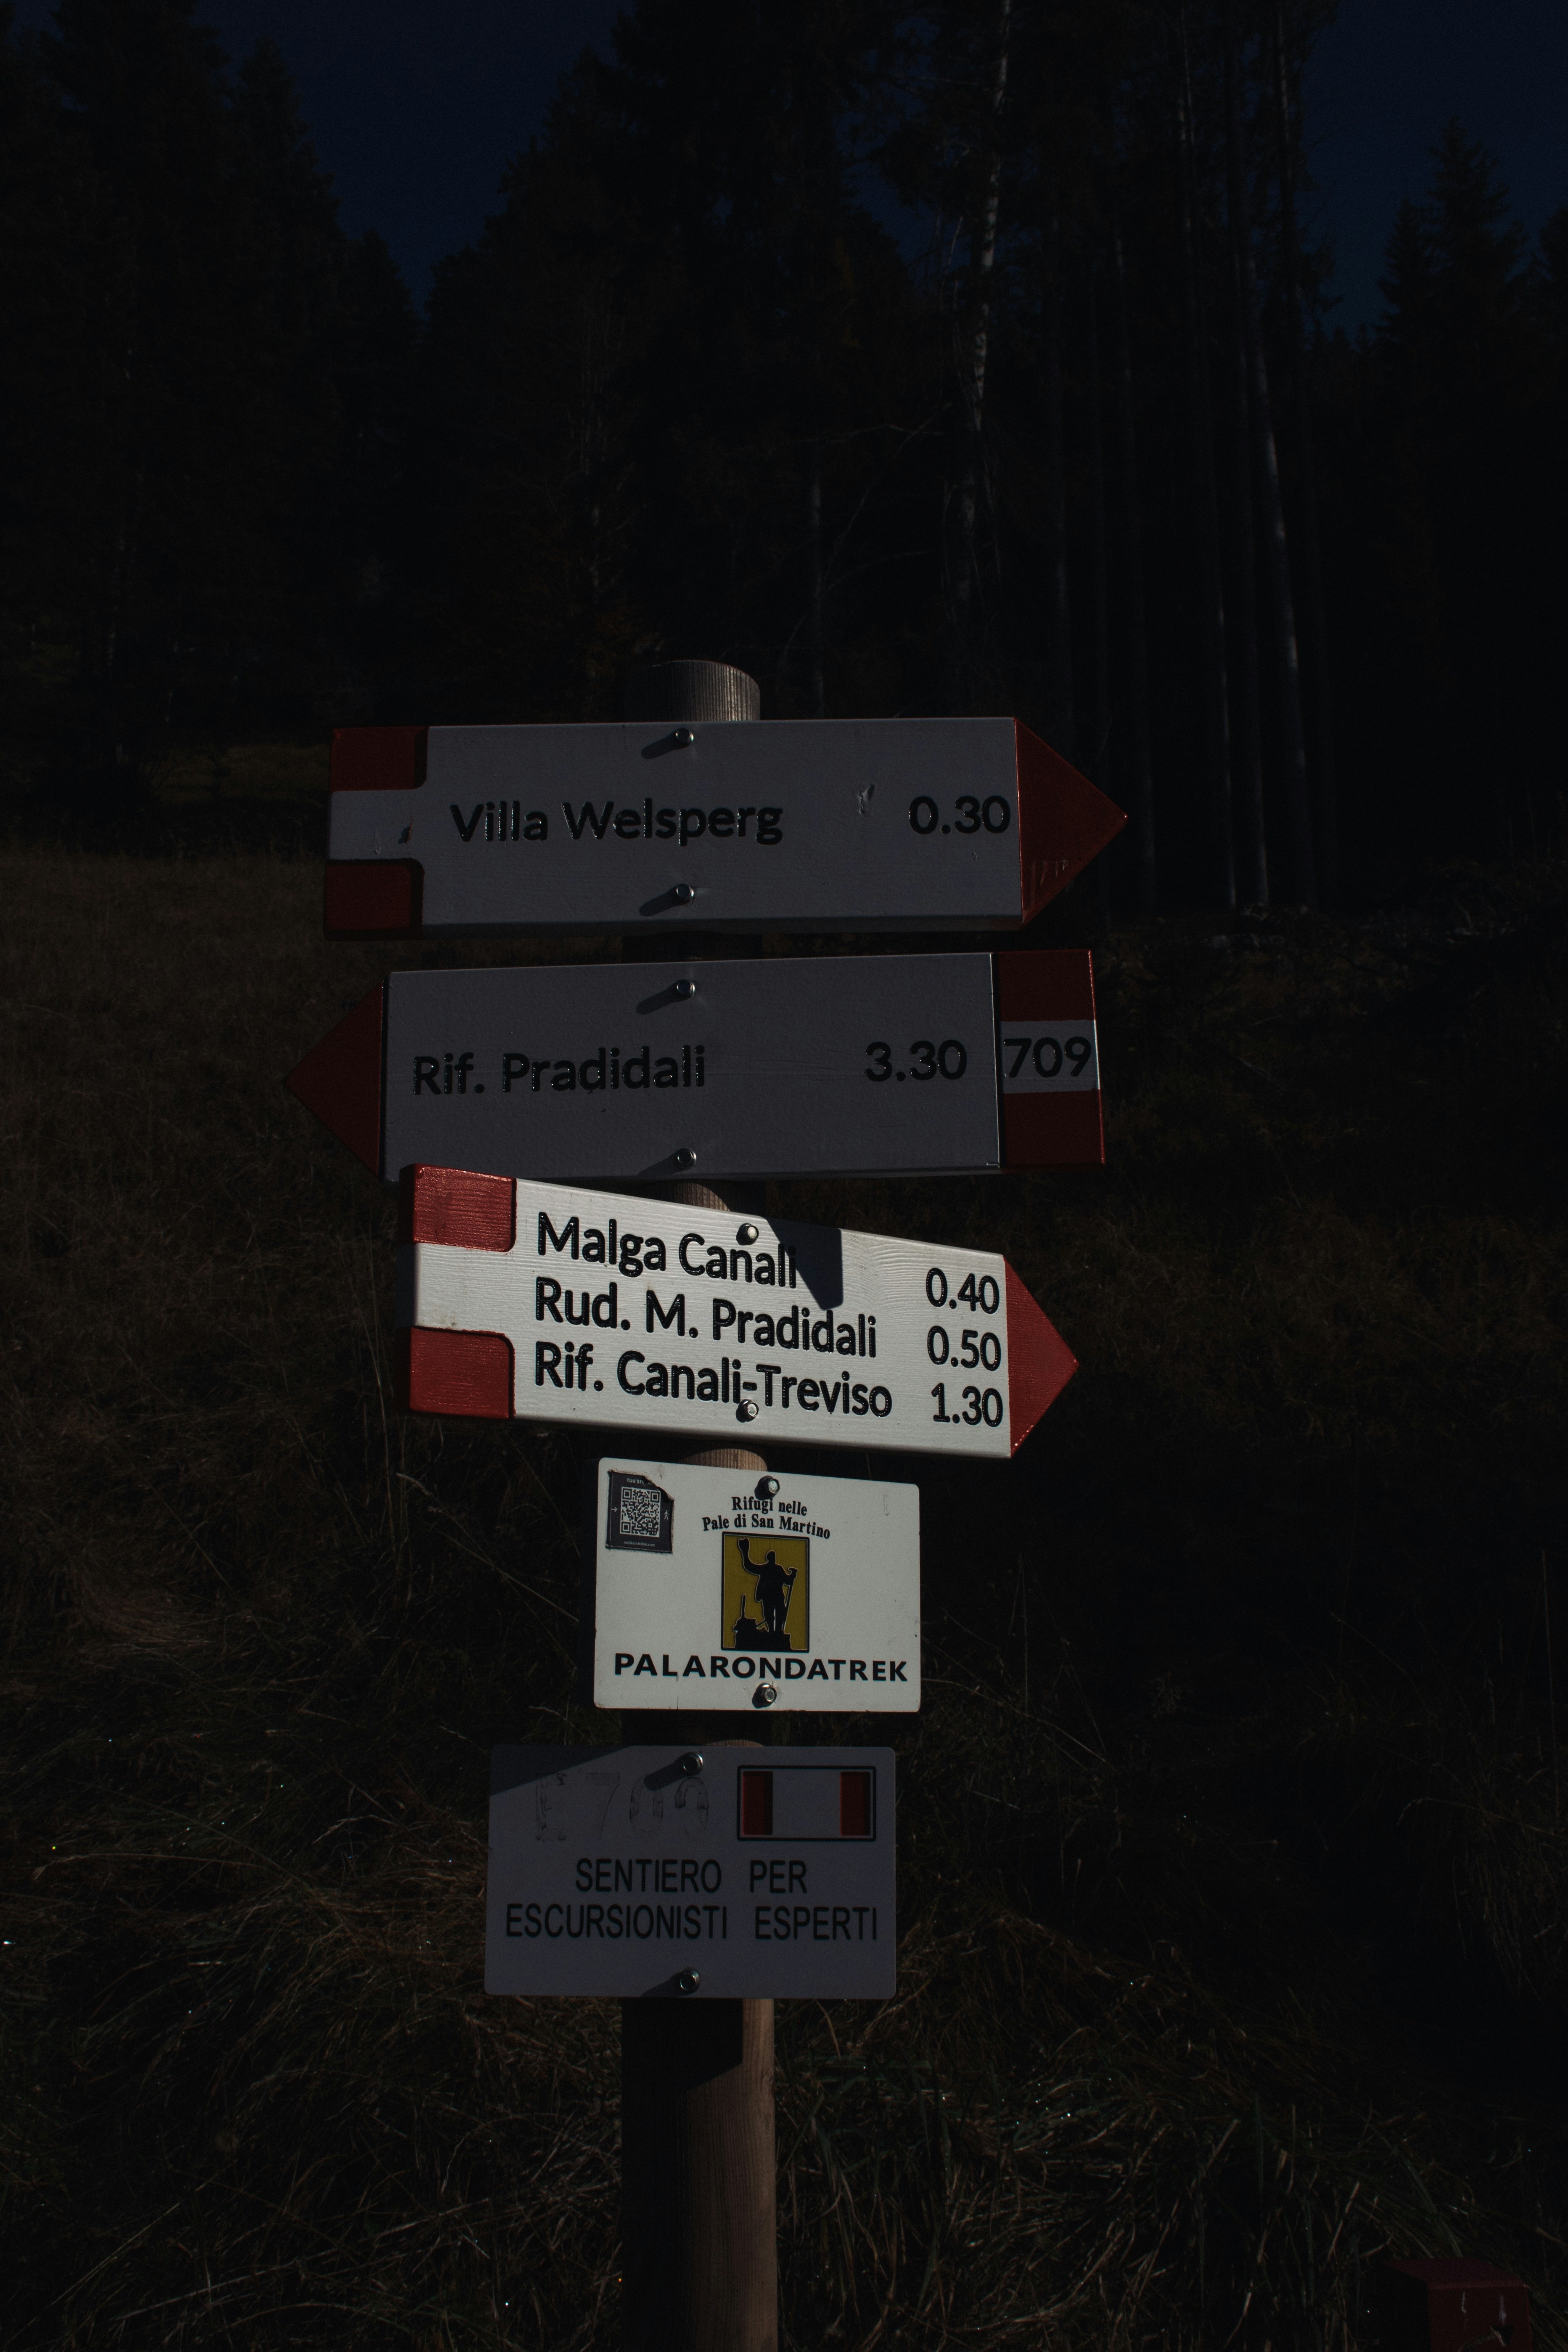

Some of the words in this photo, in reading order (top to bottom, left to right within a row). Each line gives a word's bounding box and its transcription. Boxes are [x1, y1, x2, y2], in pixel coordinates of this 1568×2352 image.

[449, 801, 548, 842] Villa
[562, 797, 783, 846] Welsperg
[908, 795, 1011, 835] 0.30
[412, 1053, 486, 1095] Rif.
[502, 1045, 706, 1092] Pradidali
[865, 1039, 968, 1081] 3.30
[1003, 1036, 1092, 1078] 709
[538, 1211, 666, 1277] Malga
[678, 1233, 796, 1289] Canali
[926, 1267, 999, 1314] 0.40
[535, 1277, 630, 1330] Rud.
[646, 1290, 698, 1338] M.
[713, 1299, 876, 1358] Pradidali
[927, 1325, 1000, 1371] 0.50
[535, 1341, 604, 1391] Rif.
[617, 1350, 891, 1418] Canali-Treviso
[931, 1383, 1002, 1427] 1.30
[702, 1515, 729, 1531] Pale
[734, 1514, 746, 1527] di
[751, 1514, 774, 1528] San
[779, 1516, 830, 1539] Martino
[732, 1497, 773, 1514] Rifugi
[778, 1501, 807, 1516] nelle
[614, 1653, 907, 1682] PALARONDATREK
[576, 1858, 722, 1893] SENTIERO
[749, 1860, 807, 1894] PER
[506, 1903, 727, 1939] ESCURSIONISTI
[755, 1905, 877, 1941] ESPERTI
